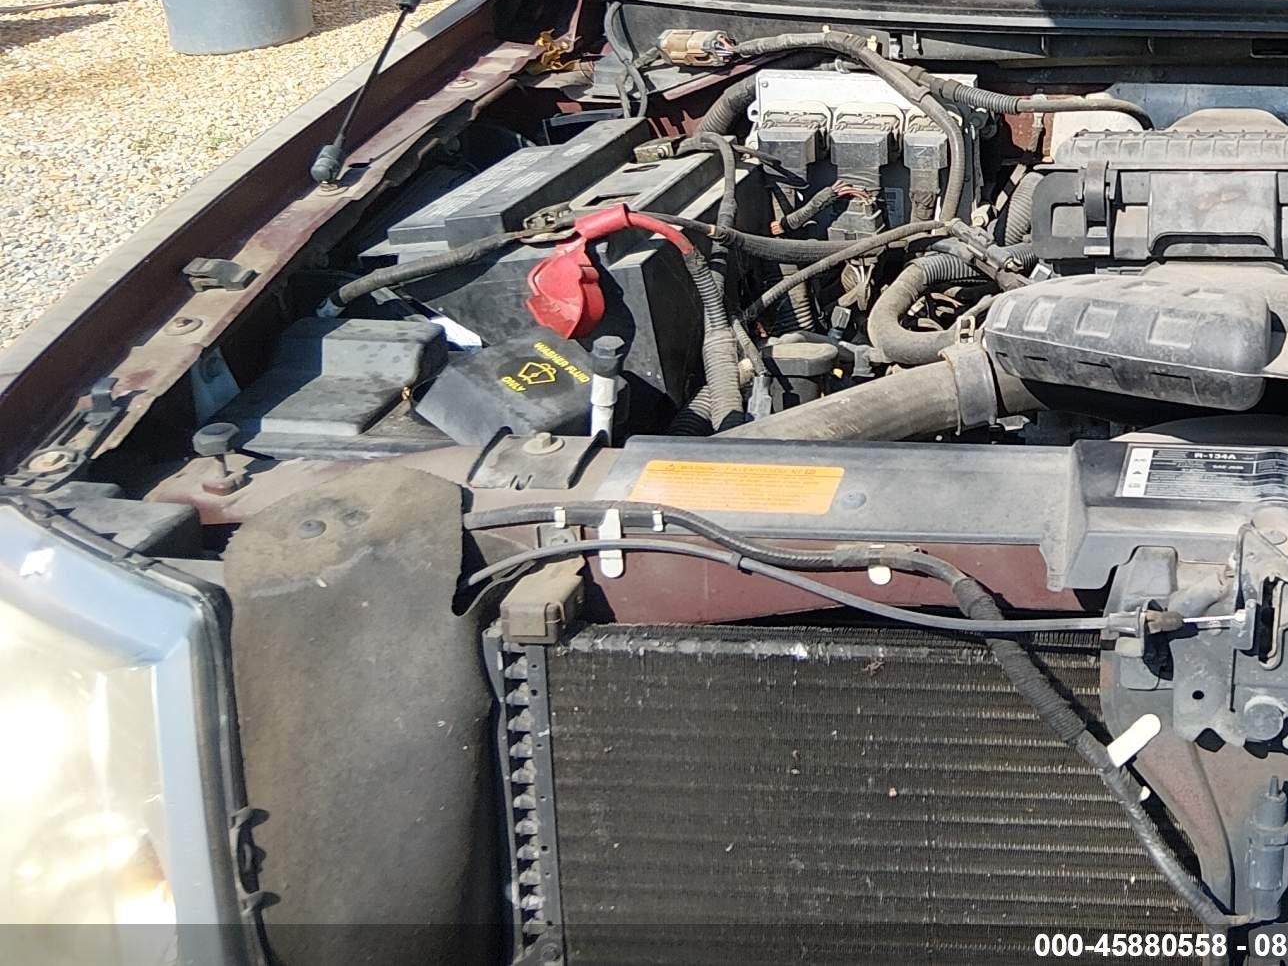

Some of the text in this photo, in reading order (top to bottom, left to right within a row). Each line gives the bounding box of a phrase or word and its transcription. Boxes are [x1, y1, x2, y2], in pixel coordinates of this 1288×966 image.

[533, 341, 591, 384] WASHER FLUID
[501, 376, 527, 392] ONLY
